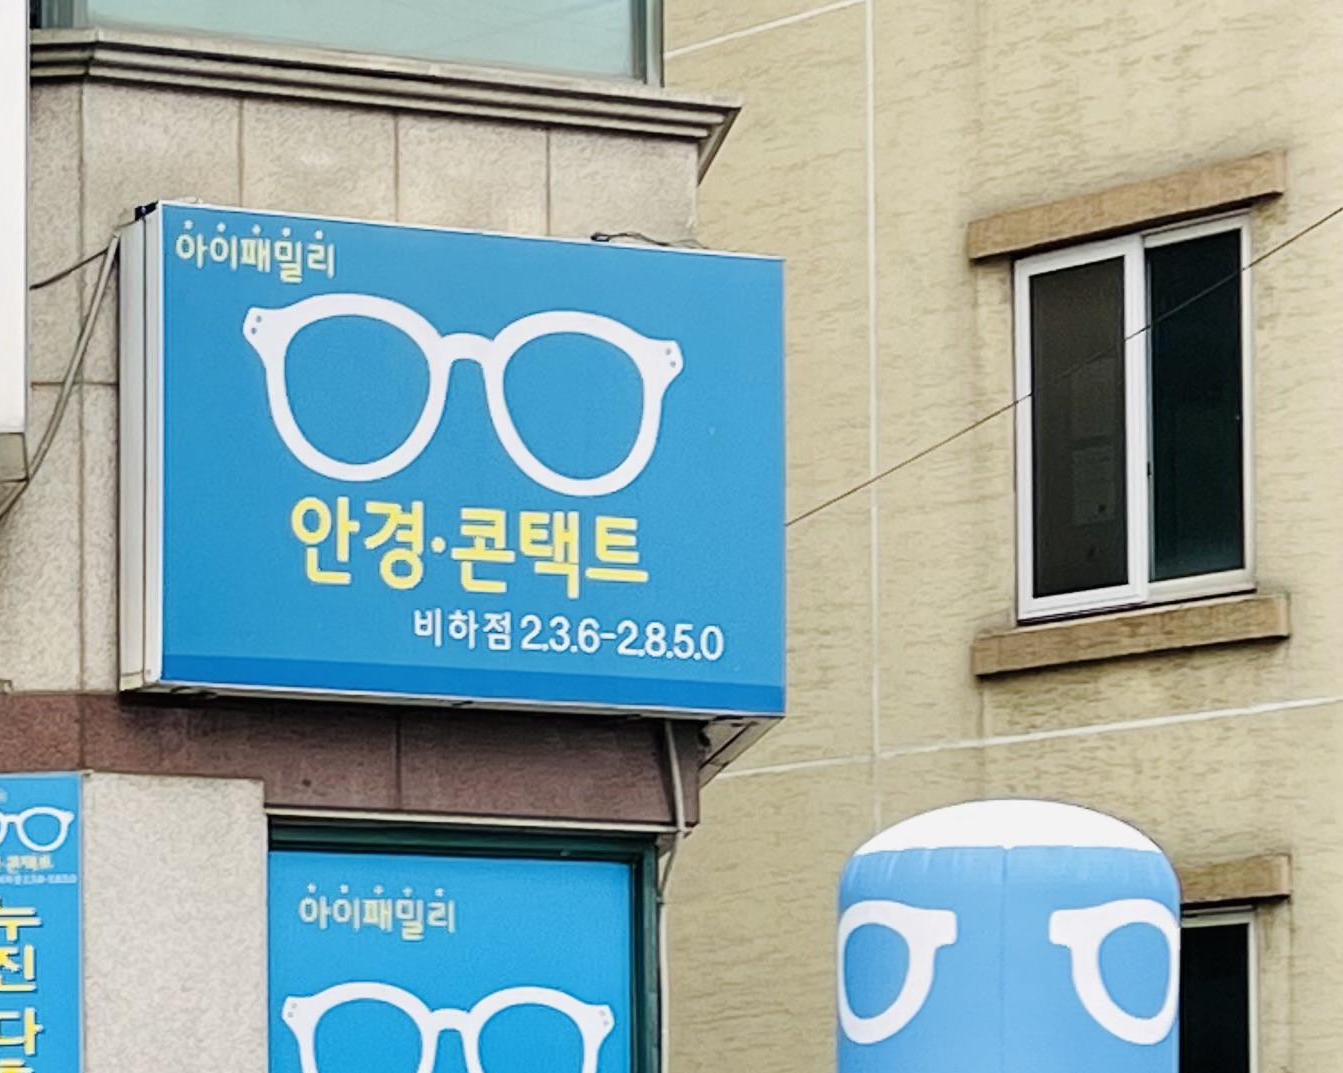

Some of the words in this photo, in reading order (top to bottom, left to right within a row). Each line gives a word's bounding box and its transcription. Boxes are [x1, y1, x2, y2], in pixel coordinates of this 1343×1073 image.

[176, 221, 335, 282] 아이패밀리
[415, 609, 510, 650] 비하점
[521, 615, 723, 660] 2.3.6-2.8.5.0
[300, 884, 454, 940] 아이패밀리
